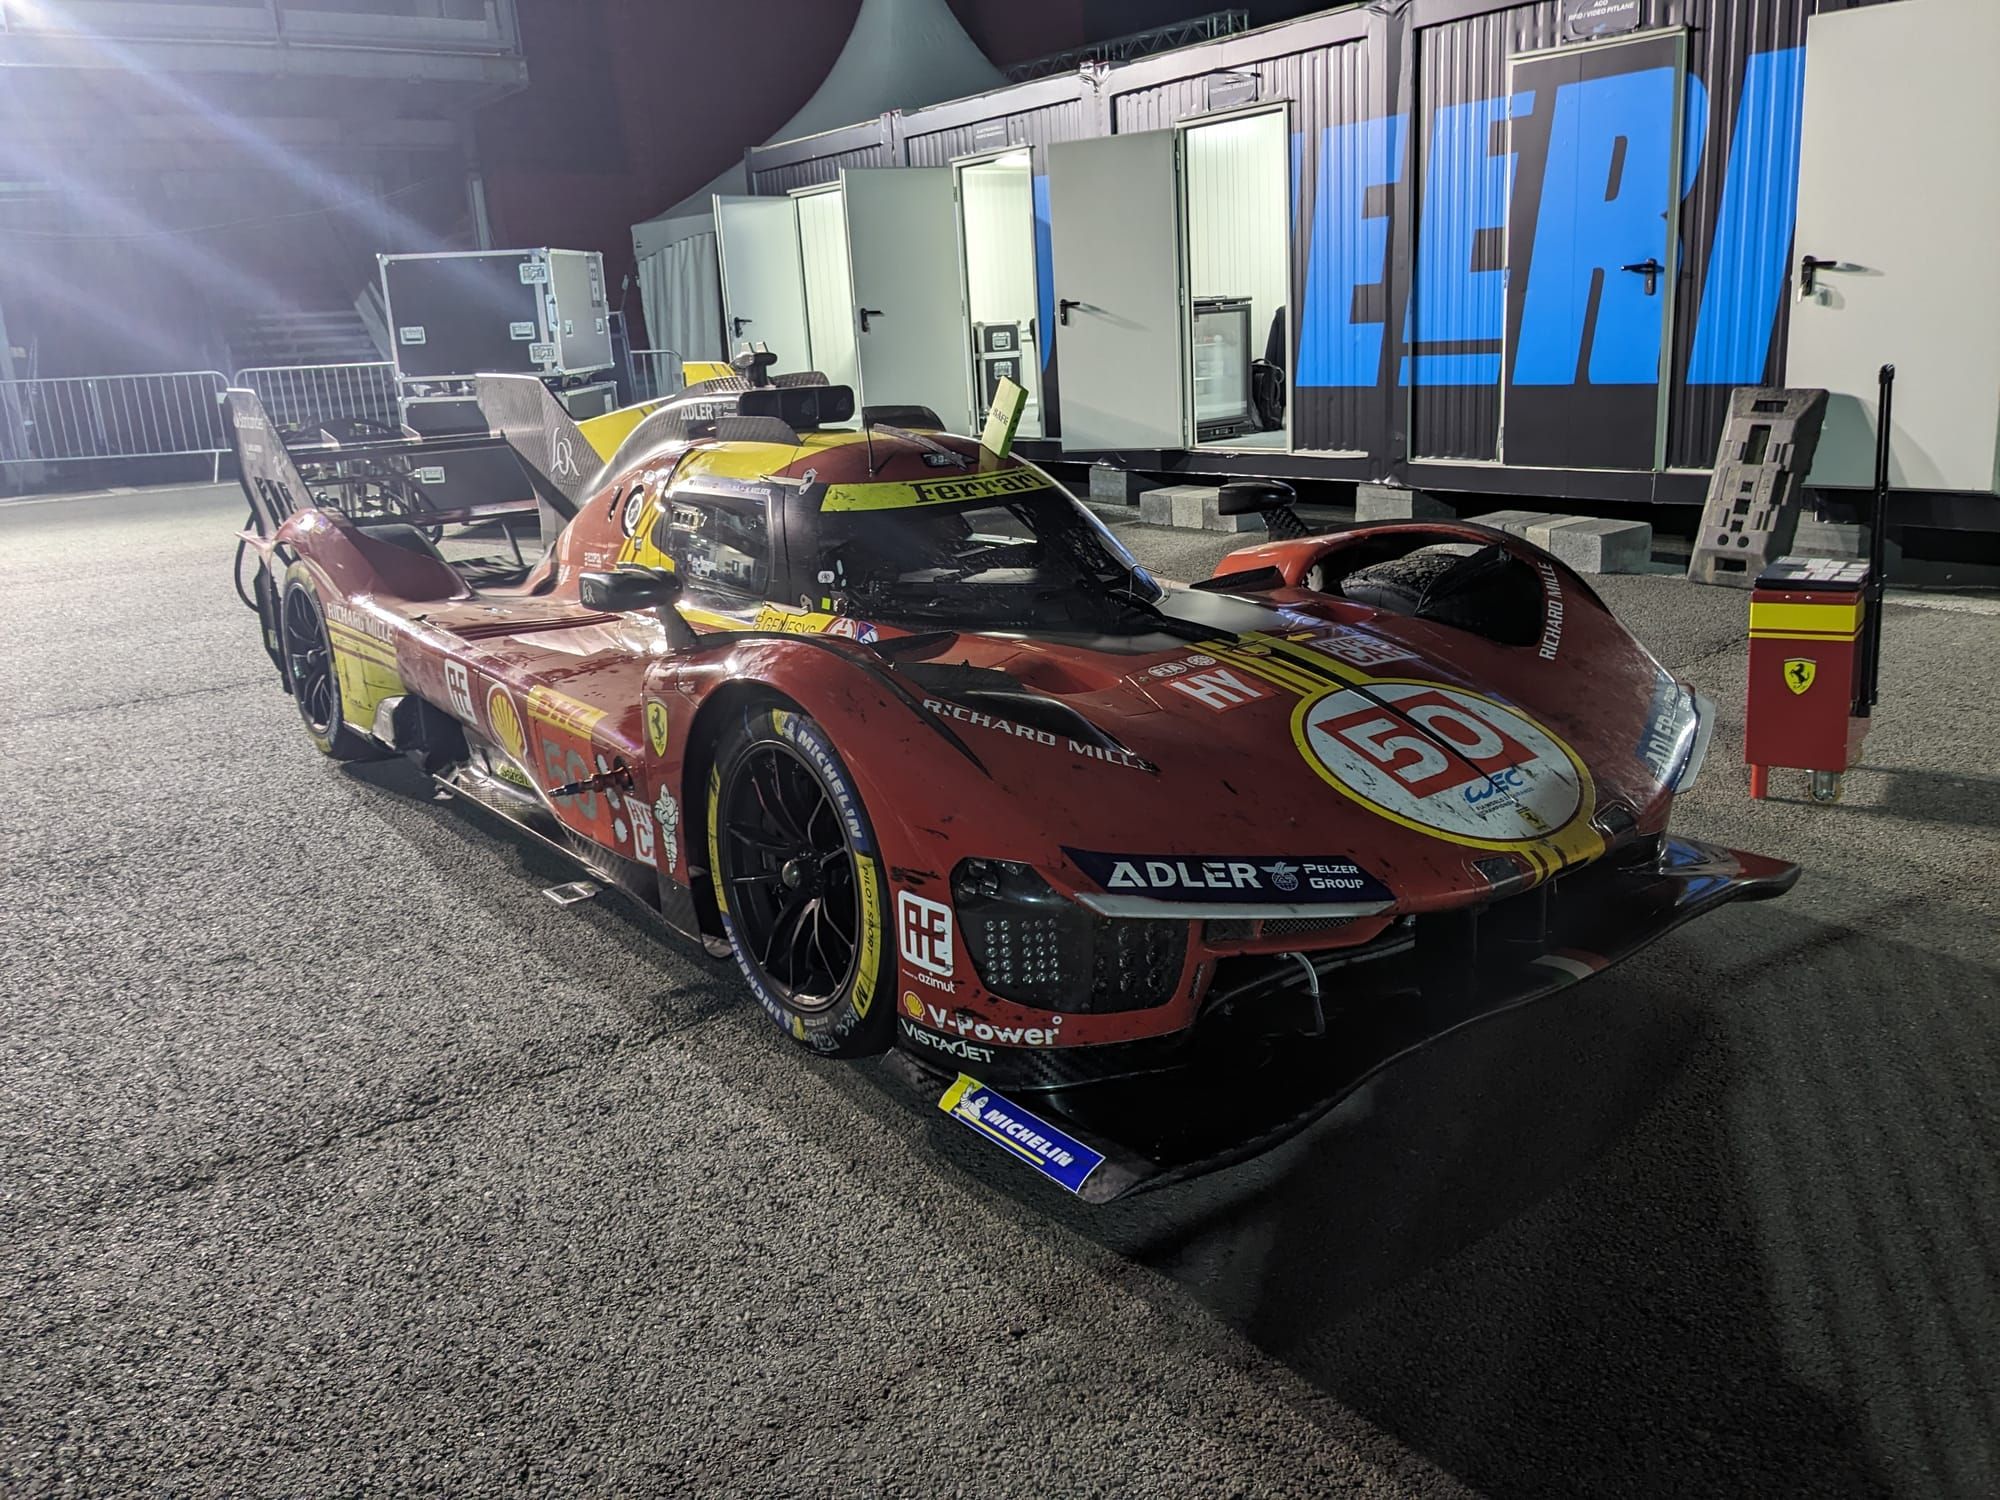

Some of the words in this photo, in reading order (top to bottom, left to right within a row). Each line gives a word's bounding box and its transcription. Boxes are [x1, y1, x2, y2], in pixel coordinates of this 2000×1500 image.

[1586, 7, 1606, 18] VIDEO
[1606, 2, 1635, 13] PITLANE
[680, 402, 714, 421] ADLER
[992, 407, 1009, 426] SAFE
[909, 469, 1047, 504] Ferrari
[1537, 561, 1564, 600] MILLE
[1538, 599, 1564, 661] RICHARD
[1169, 668, 1263, 710] HY
[536, 692, 596, 733] DHL
[922, 698, 1057, 747] RICHARD
[1338, 704, 1504, 784] 50
[541, 736, 599, 821] 50
[796, 728, 863, 839] MICHELIN
[1465, 767, 1524, 804] WEC
[861, 863, 874, 909] PILOT
[1106, 861, 1264, 889] ADLER
[1302, 863, 1359, 875] PELZER
[1308, 877, 1365, 889] GROUP
[918, 971, 956, 994] azimut
[927, 1004, 1061, 1046] V-Power
[982, 1108, 1075, 1168] MICHELIN
